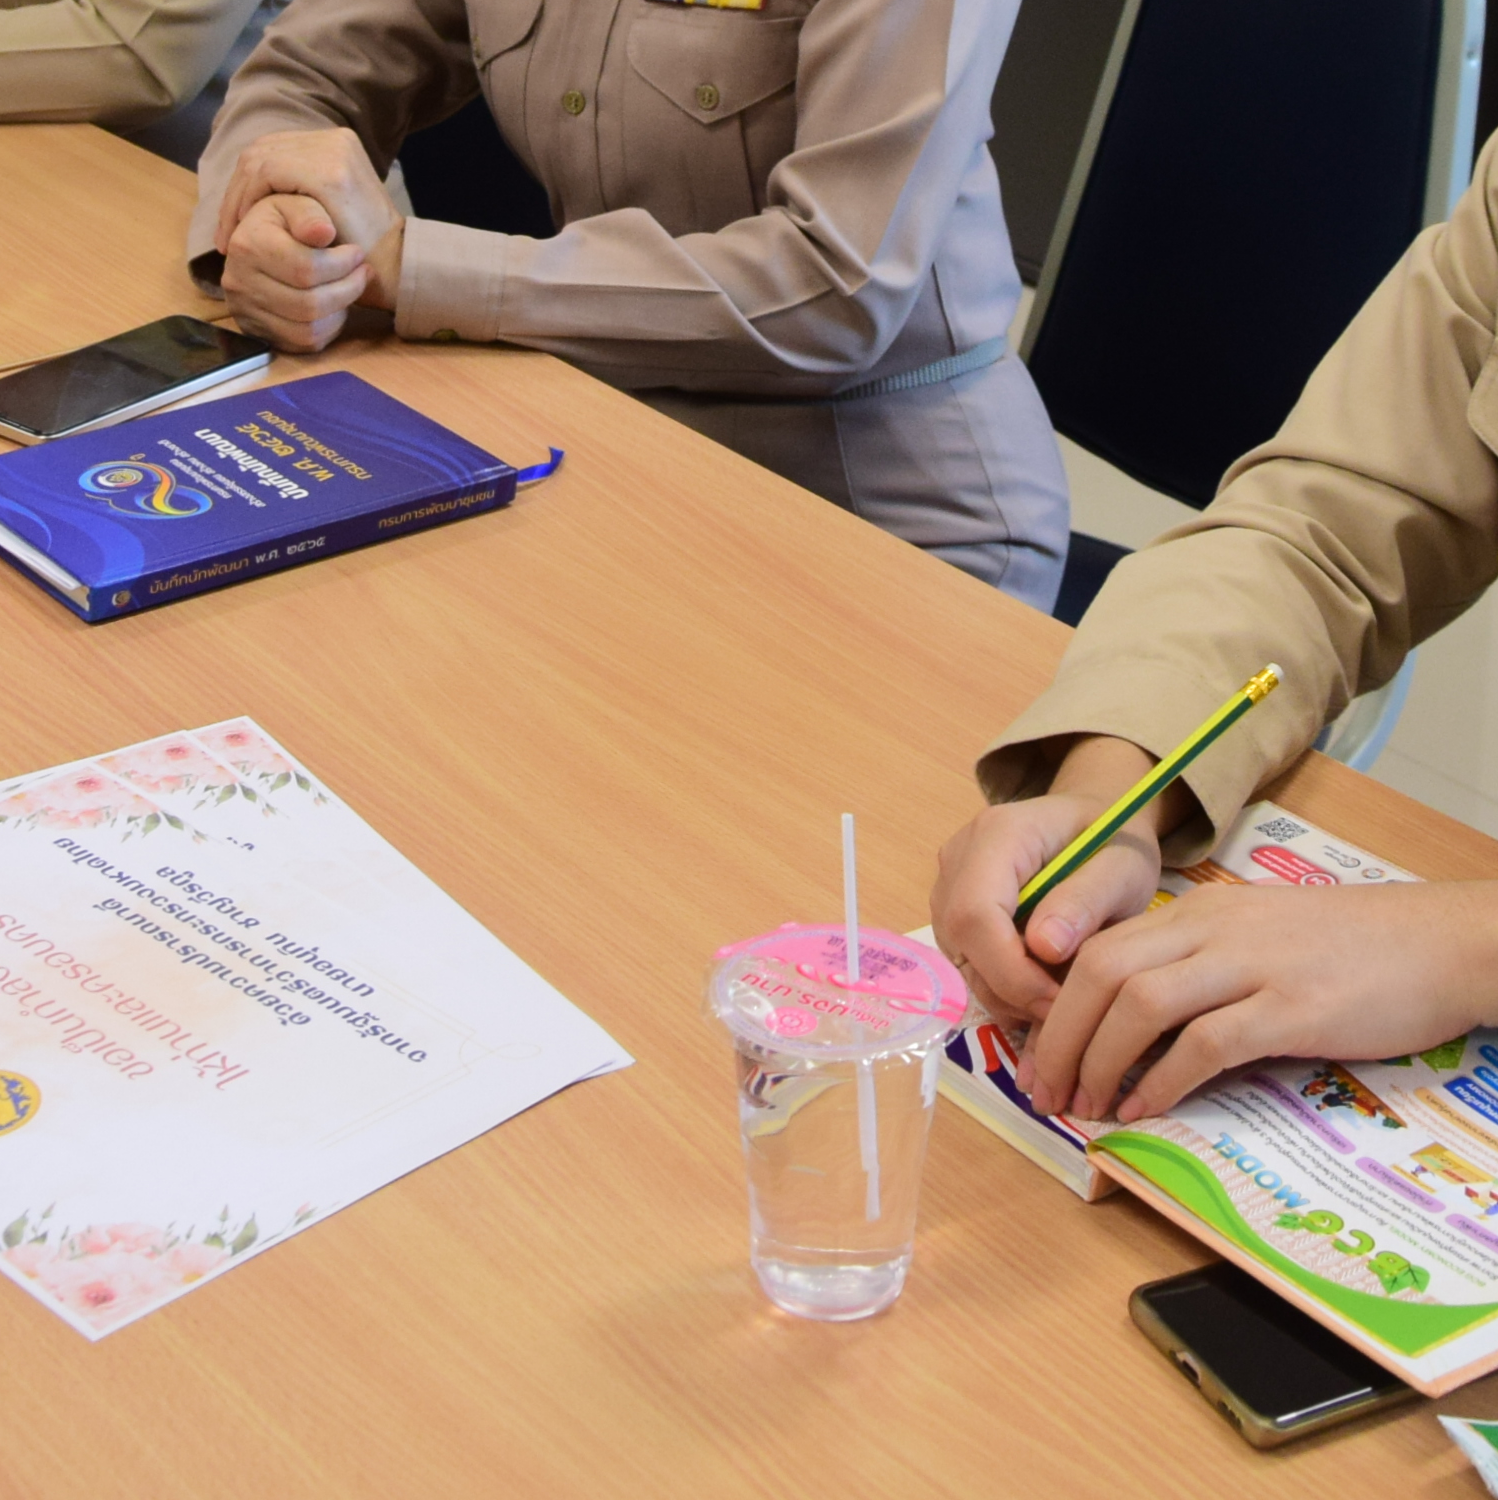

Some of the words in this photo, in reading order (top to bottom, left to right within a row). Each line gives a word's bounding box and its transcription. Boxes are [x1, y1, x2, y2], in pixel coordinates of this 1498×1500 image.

[194, 428, 310, 501] บันทึกนักพัฒนา
[256, 410, 373, 480] กรมการพัฒนาชุมชน
[291, 458, 334, 481] พ.ศ.
[378, 488, 496, 532] กรมการพัฒนาชุมชน
[150, 556, 249, 596] บันทึกนักพัฒนา
[155, 865, 260, 931] ชาญวีรกูล
[51, 836, 428, 1064] จากรัฐมนตรีว่าการกระทรวงมหาดไทย
[95, 896, 312, 1028] ด้วยความปรารถนาดี
[264, 930, 376, 998] นายอนุทิน
[1209, 1132, 1309, 1209] MODEL
[1299, 1209, 1410, 1279] BCG
